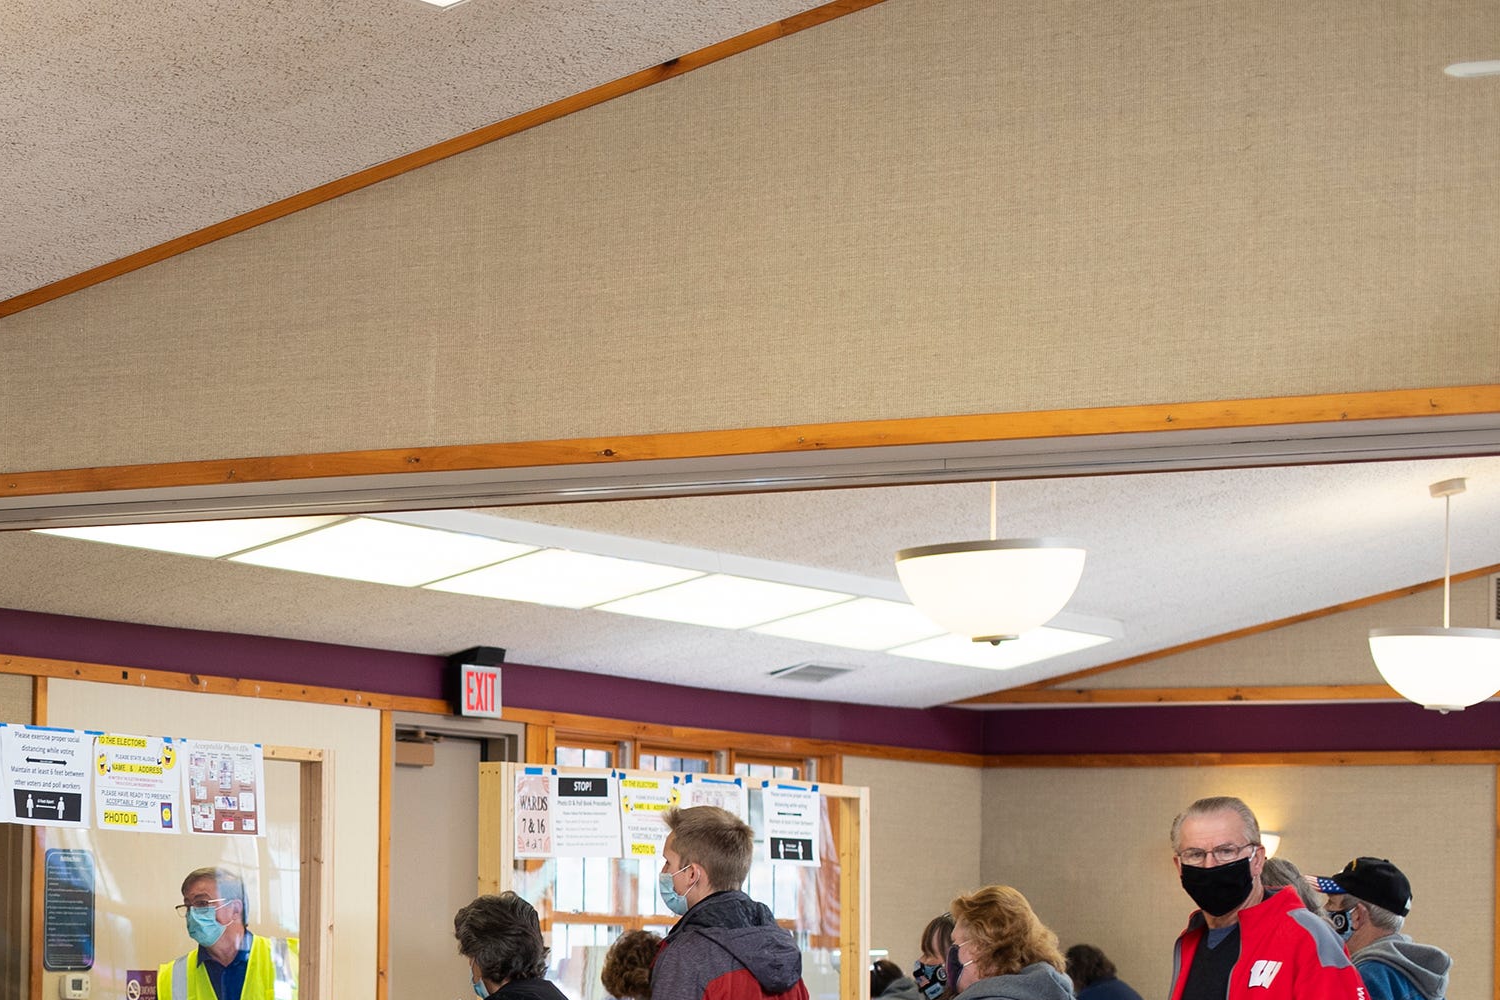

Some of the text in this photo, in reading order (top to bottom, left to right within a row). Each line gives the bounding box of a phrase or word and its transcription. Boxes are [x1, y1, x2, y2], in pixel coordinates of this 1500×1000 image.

[466, 671, 497, 712] EXIT
[106, 736, 116, 744] THE
[22, 745, 45, 754] distancing
[139, 766, 162, 774] ADDRESS
[574, 781, 592, 791] STOP!
[520, 796, 547, 811] WARDS
[104, 813, 137, 824] PHOTO ID
[522, 818, 526, 833] 7
[528, 818, 535, 833] &
[537, 819, 545, 834] 16
[632, 844, 649, 854] PHOTO
[1248, 960, 1283, 989] W
